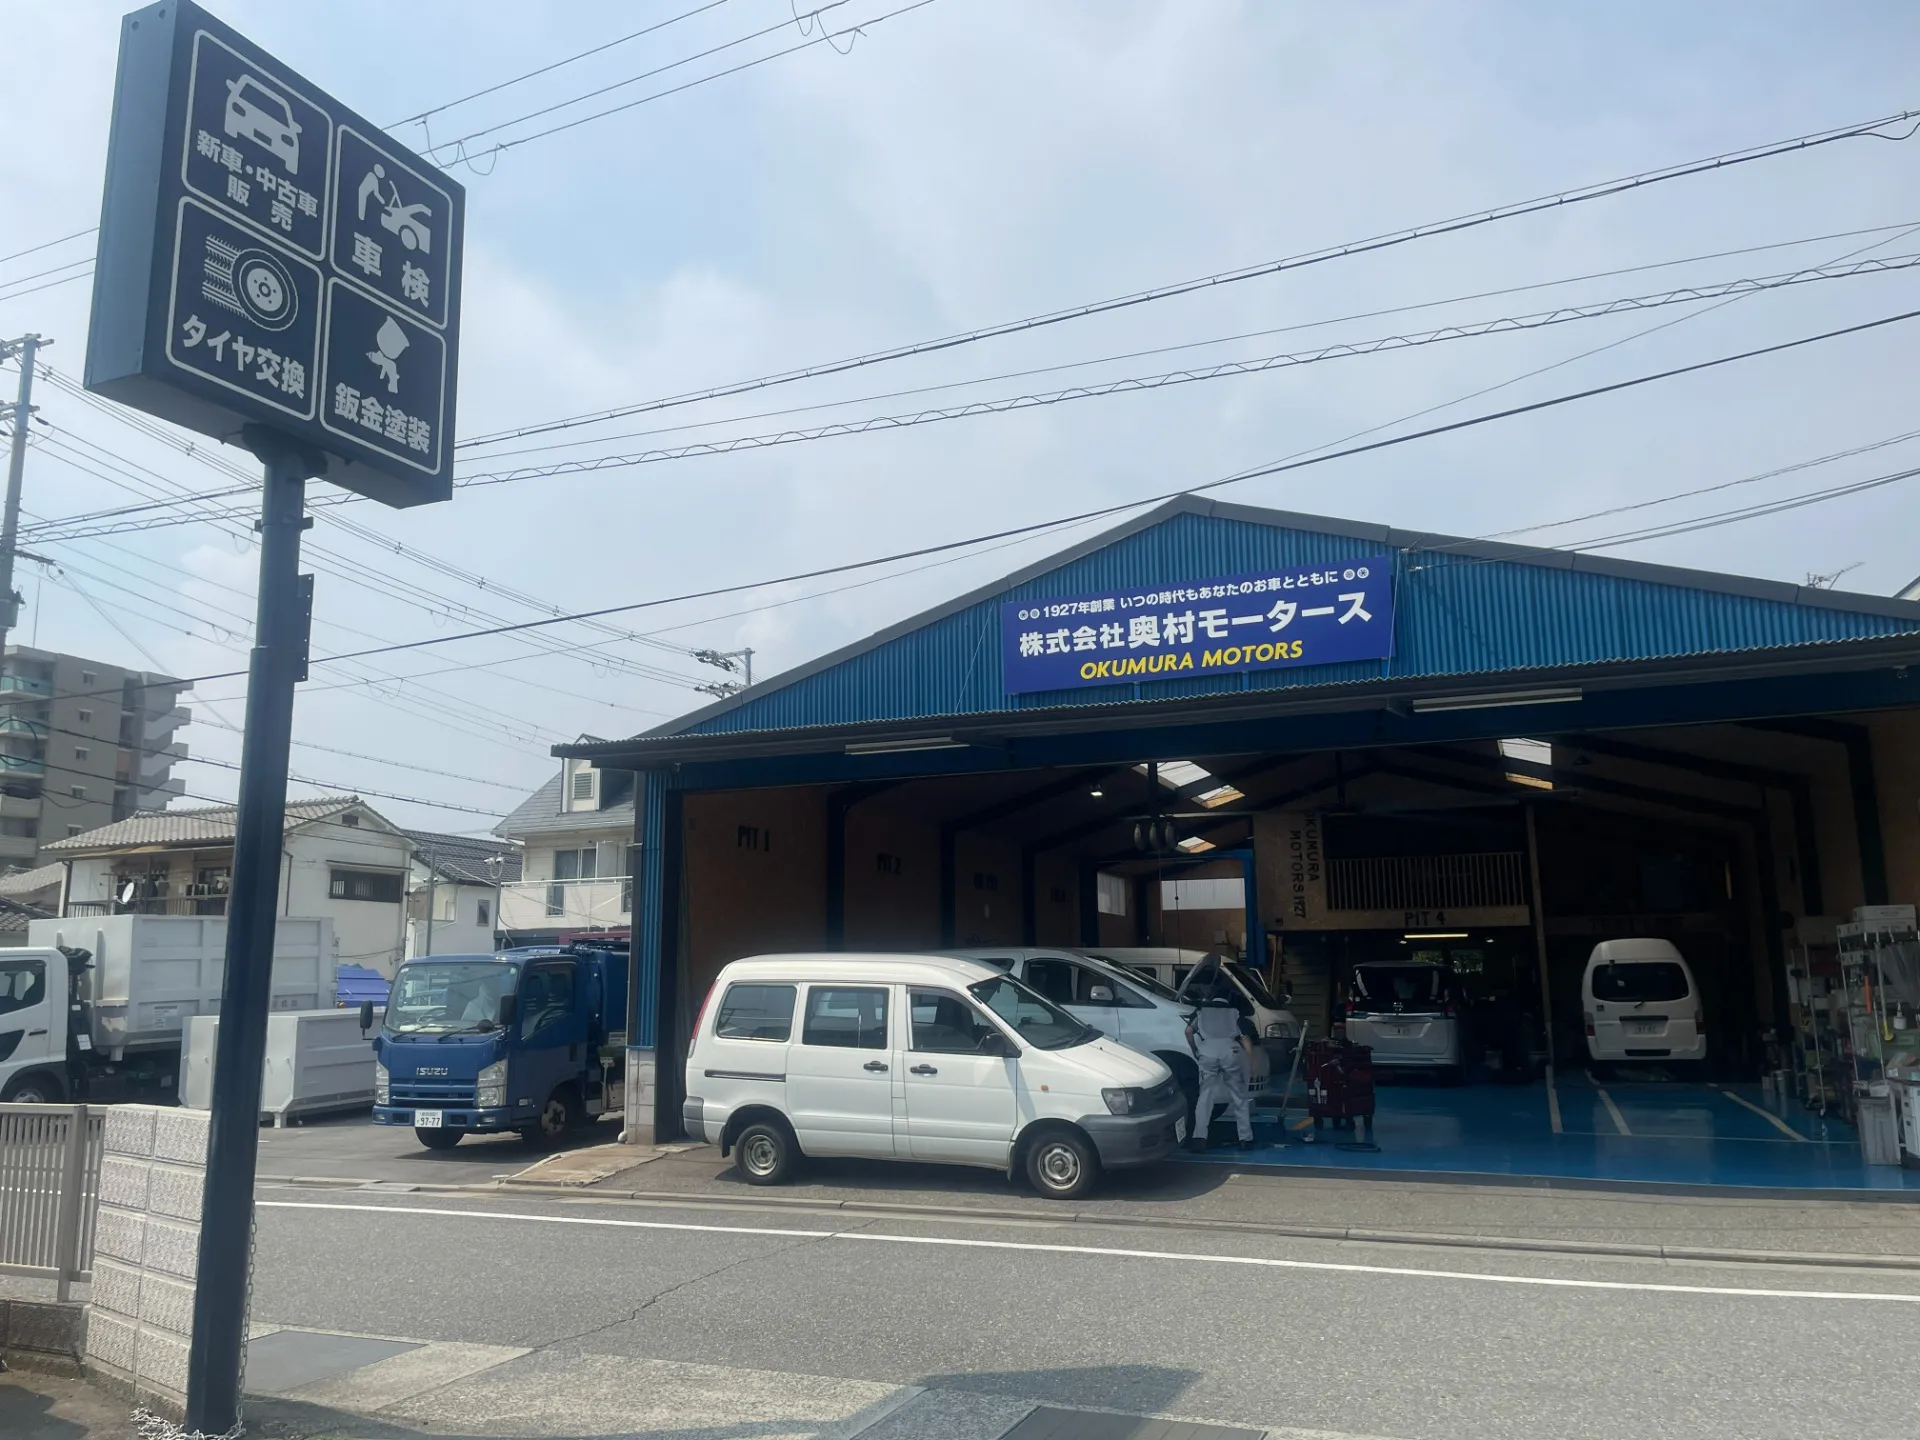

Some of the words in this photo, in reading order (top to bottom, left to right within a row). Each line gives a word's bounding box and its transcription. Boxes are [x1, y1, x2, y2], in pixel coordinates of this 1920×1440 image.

[182, 314, 305, 399] タイヤ交換
[334, 382, 431, 454] 鈑金塗装
[1043, 597, 1116, 620] 1927年創業
[1120, 570, 1339, 609] いつの時代もあなたのお車とともに
[1019, 591, 1373, 658] 株式会社奥村モータース
[1080, 652, 1194, 680] OKUMURA
[1201, 640, 1303, 667] MOTORS
[1289, 830, 1304, 893] MOTORS
[1404, 910, 1431, 928] PIT
[1436, 911, 1446, 925] 4
[416, 1067, 449, 1076] ISUZU
[420, 1117, 441, 1126] 97-77
